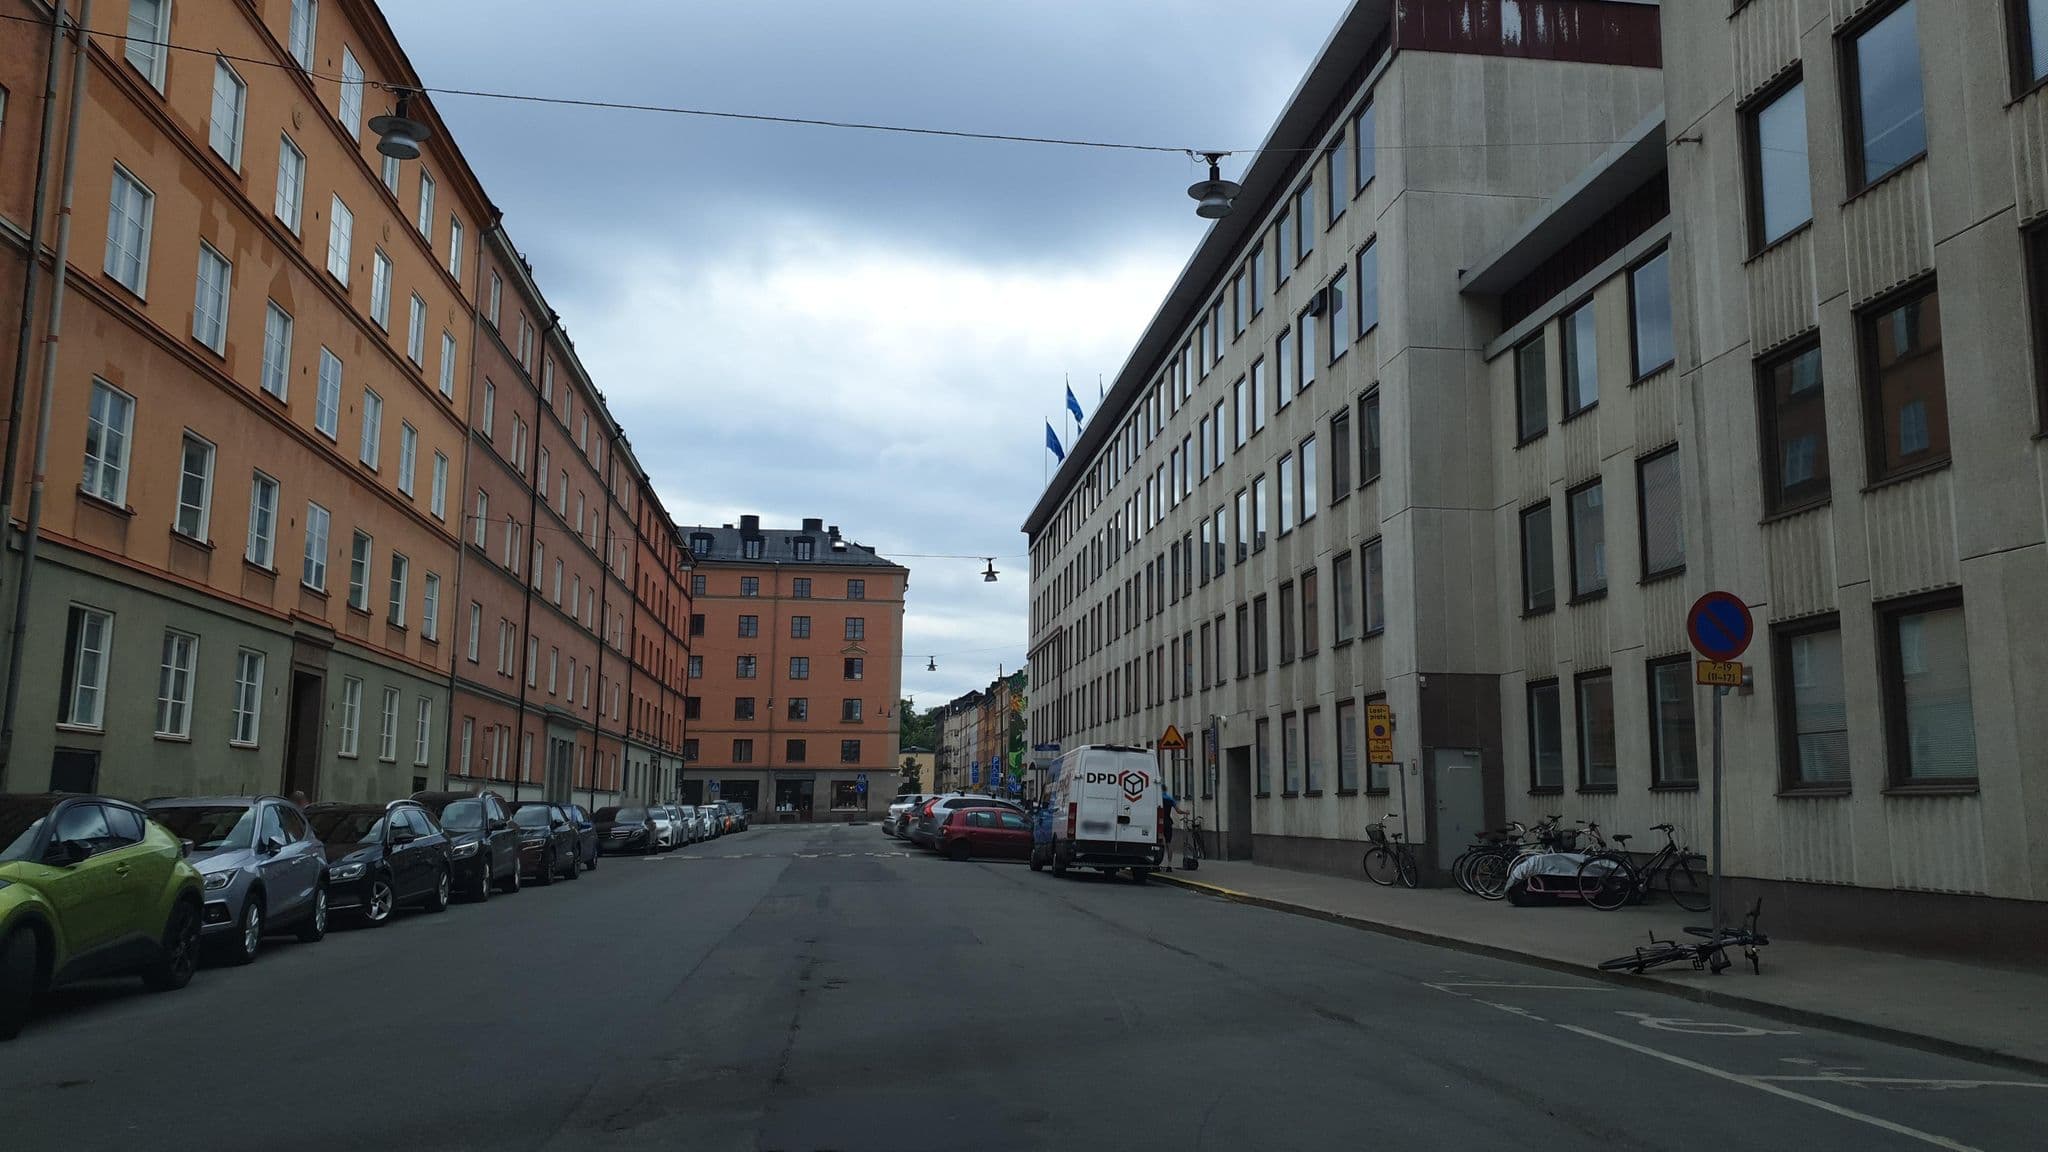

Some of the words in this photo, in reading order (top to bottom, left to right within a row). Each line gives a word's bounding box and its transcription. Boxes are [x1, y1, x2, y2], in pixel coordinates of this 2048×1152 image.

[1712, 663, 1732, 671] 7-19
[1708, 672, 1735, 682] (11-17)
[1086, 772, 1117, 785] DPD
